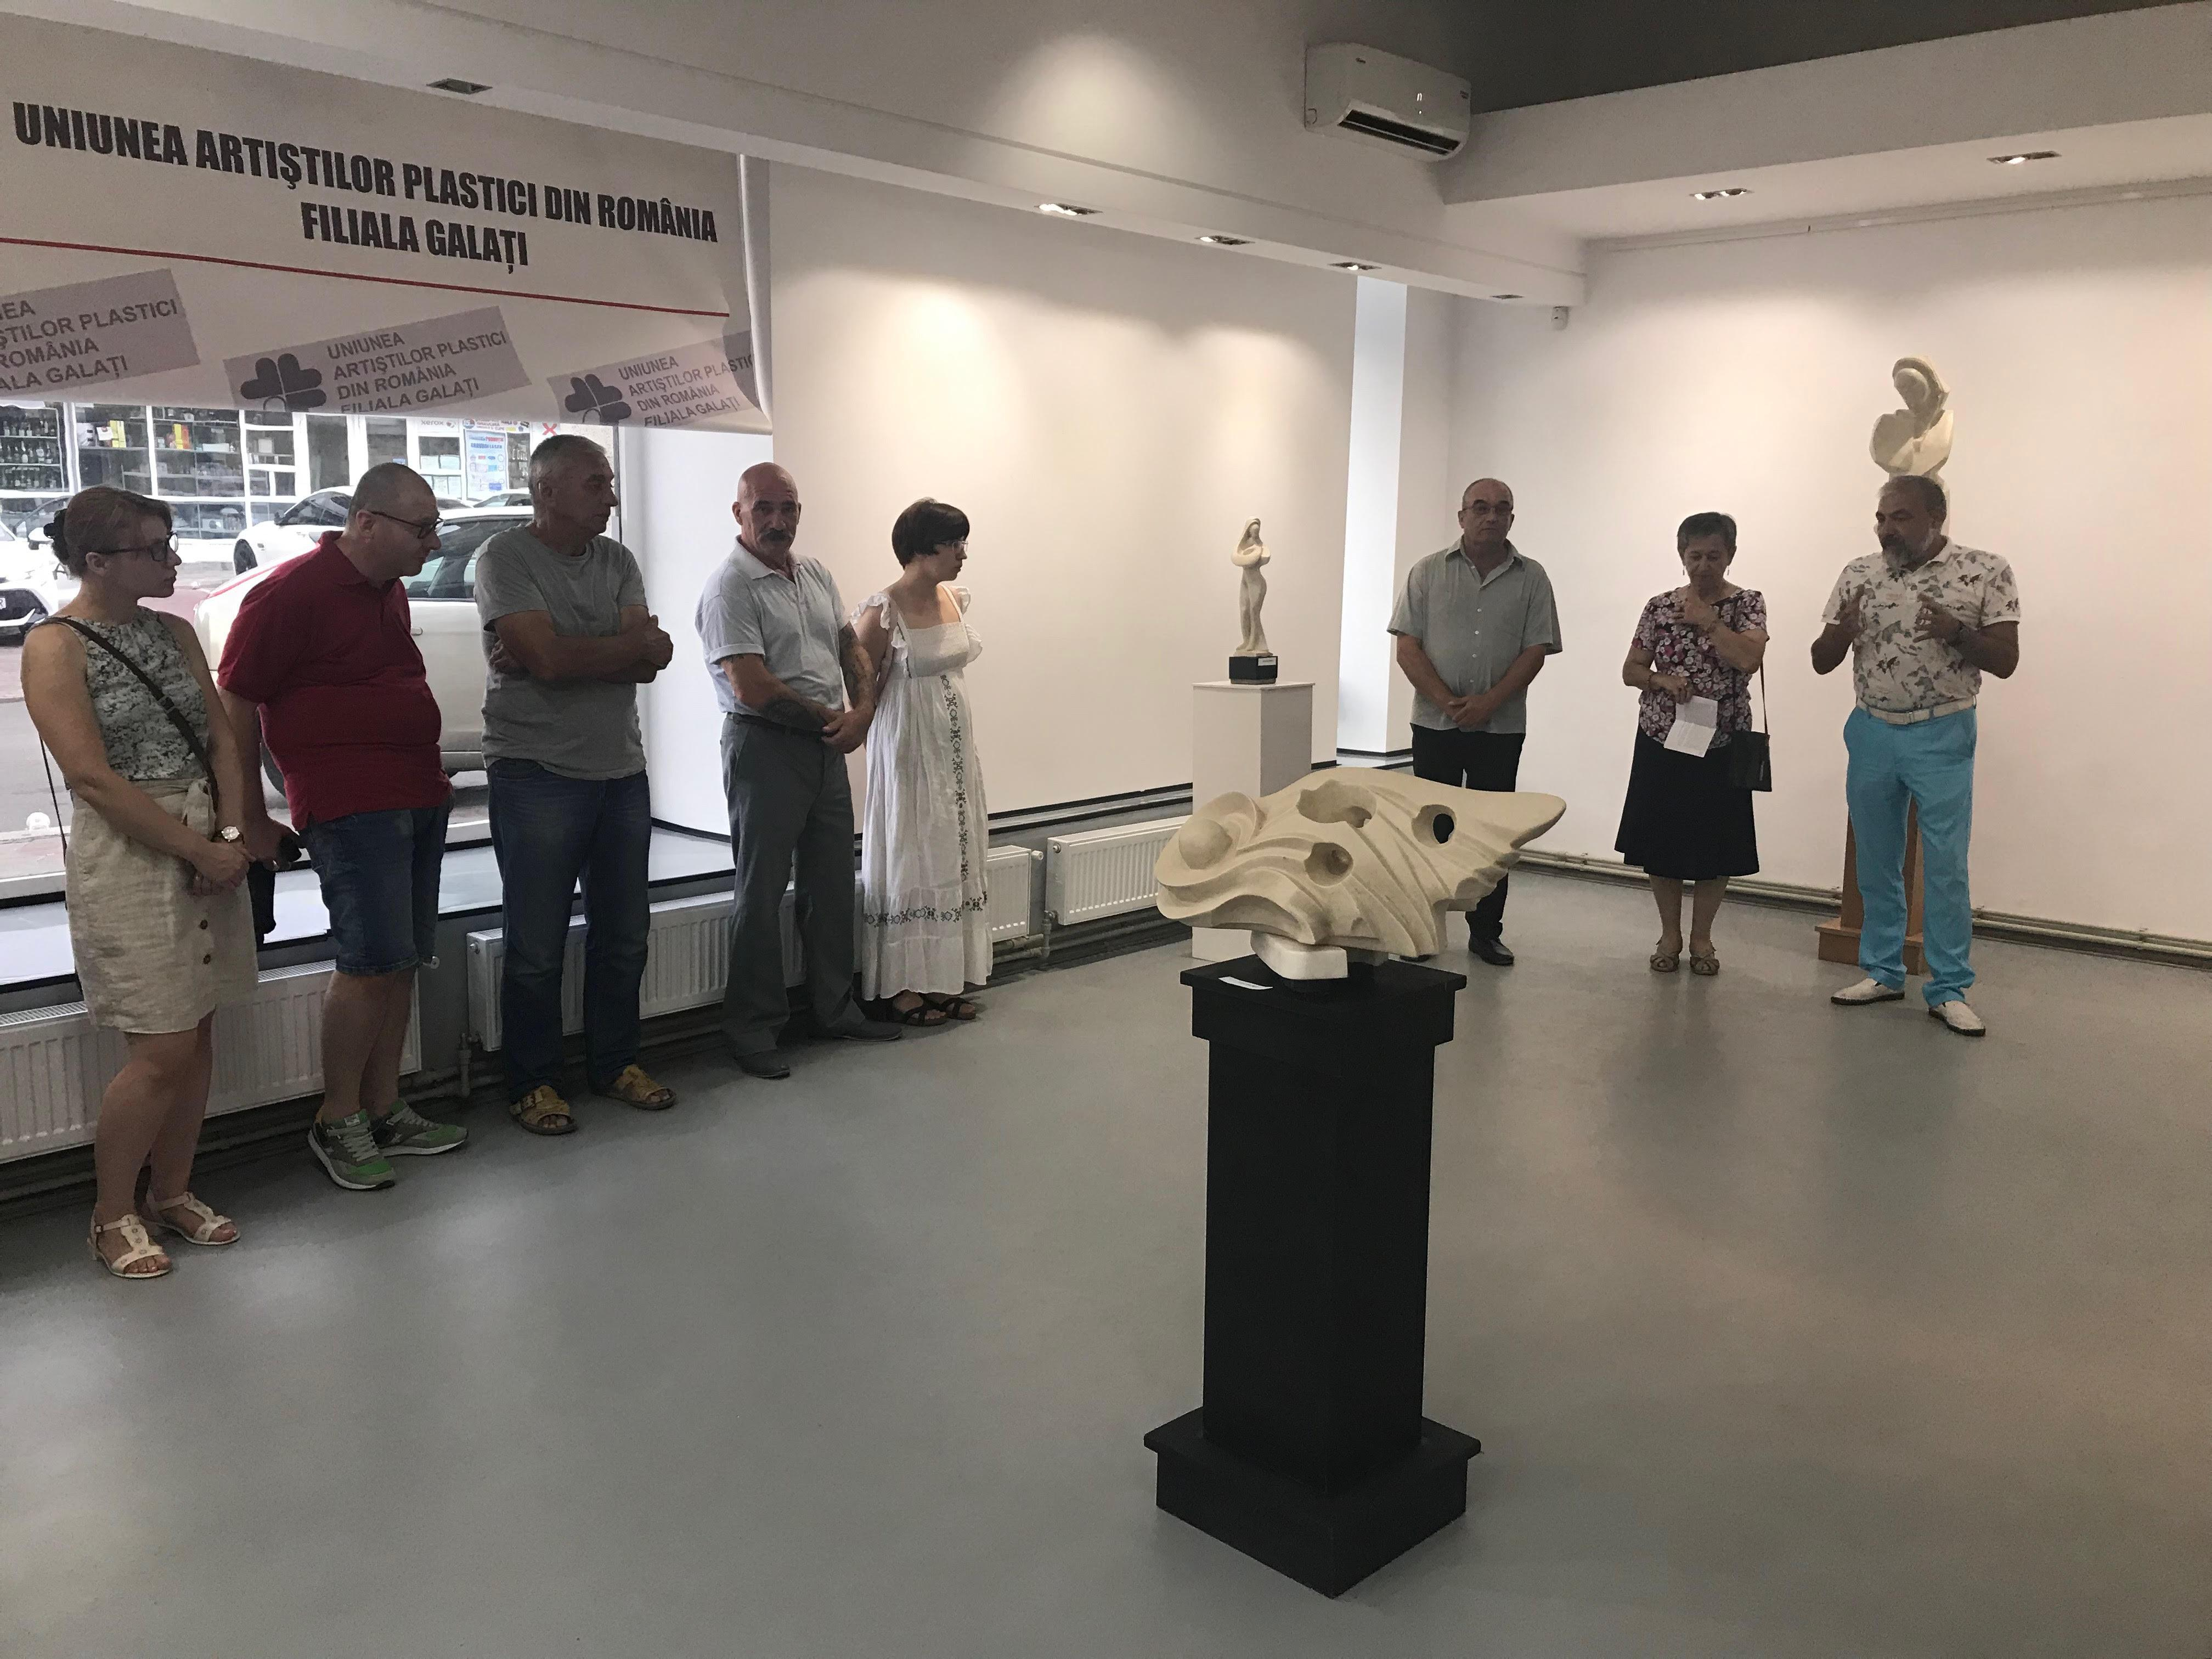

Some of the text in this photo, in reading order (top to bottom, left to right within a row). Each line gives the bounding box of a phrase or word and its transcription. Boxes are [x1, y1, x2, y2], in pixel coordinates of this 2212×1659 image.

[13, 101, 188, 166] UNIUNEA
[402, 162, 538, 217] PLASTICI
[544, 185, 591, 225] DIN
[597, 194, 718, 242] ROMÂNIA
[301, 201, 420, 252] FILIALA
[79, 299, 178, 330] PLASTICI
[328, 332, 405, 359] UNIUNEA
[437, 331, 507, 358] PLASTICI
[337, 363, 457, 400] DIN ROMÂNIA
[618, 356, 679, 380] UNIUNEA
[341, 393, 411, 413] FILIALA
[637, 384, 720, 411] DIN ROMÂNIA
[644, 407, 696, 427] FILIALA
